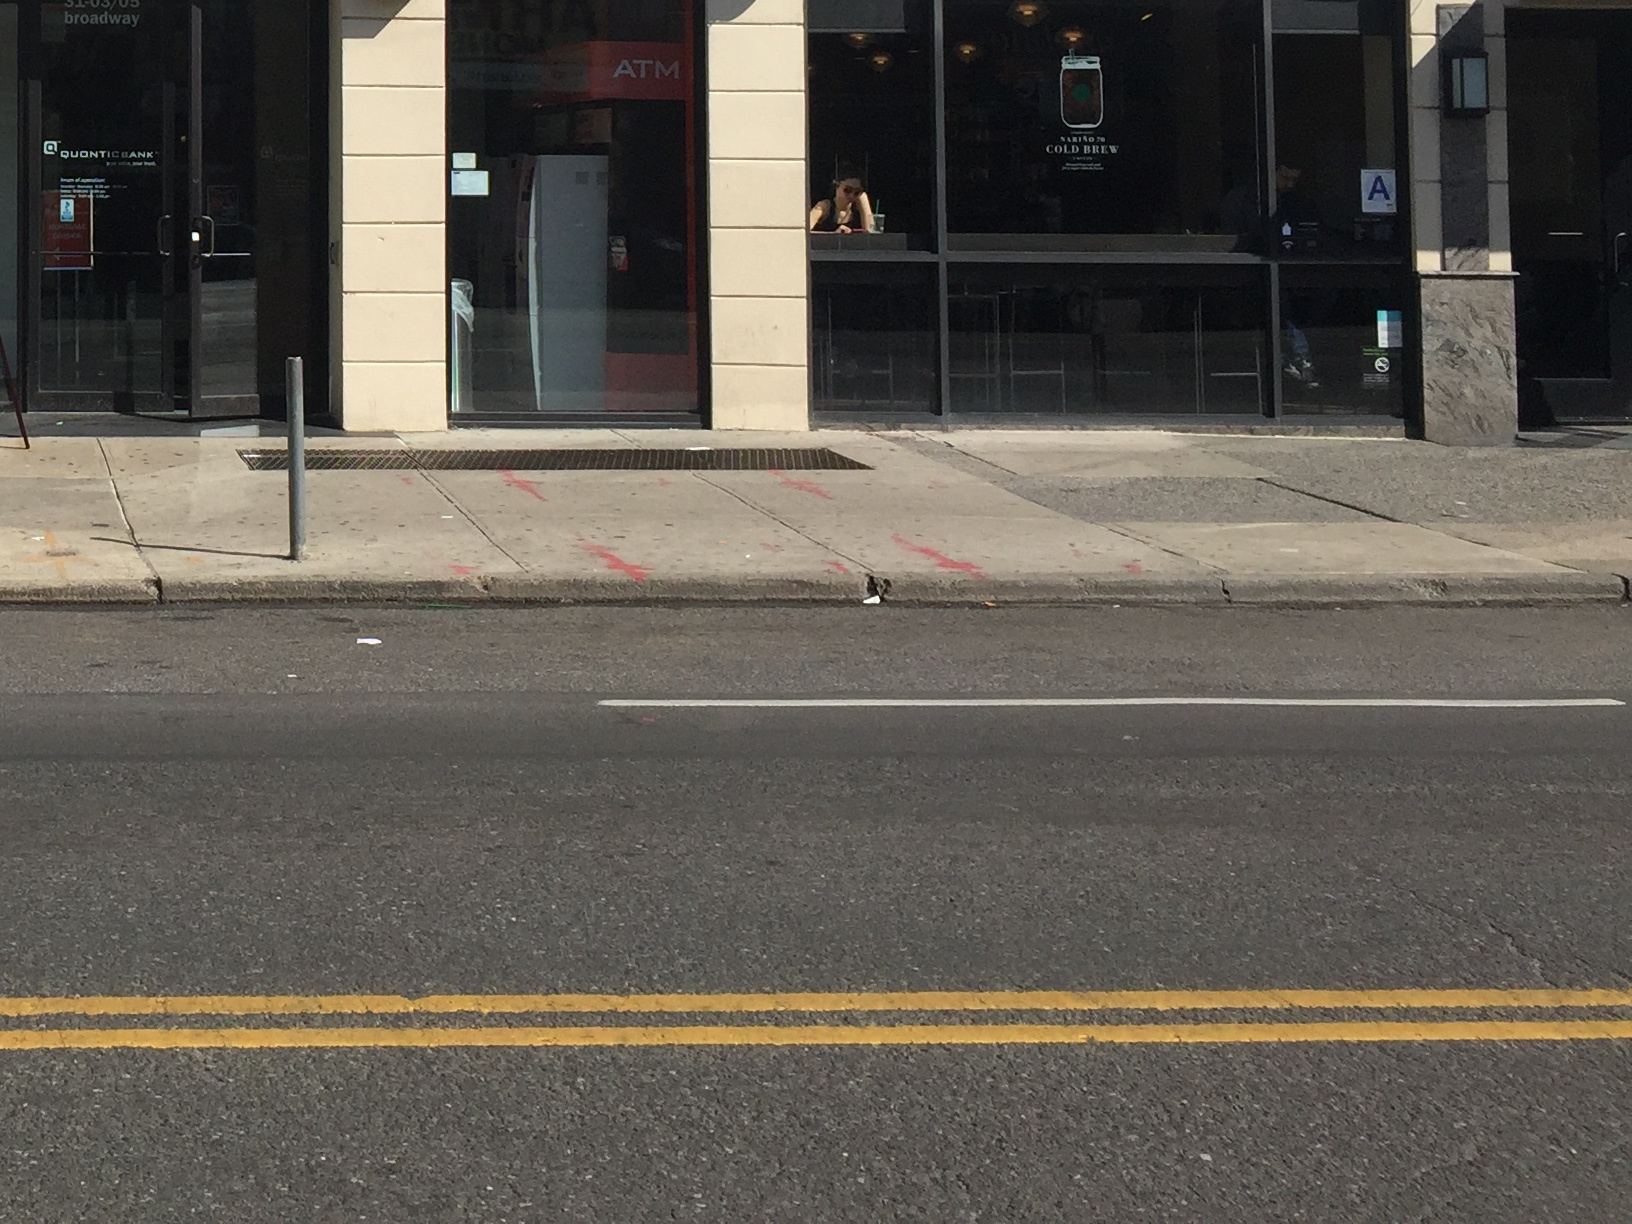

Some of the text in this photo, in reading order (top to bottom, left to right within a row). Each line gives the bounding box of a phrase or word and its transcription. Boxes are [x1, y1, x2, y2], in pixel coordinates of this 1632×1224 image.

[64, 11, 140, 27] broadway
[613, 59, 680, 79] ATM
[1046, 144, 1119, 154] COLD BREW
[1368, 175, 1390, 200] A
